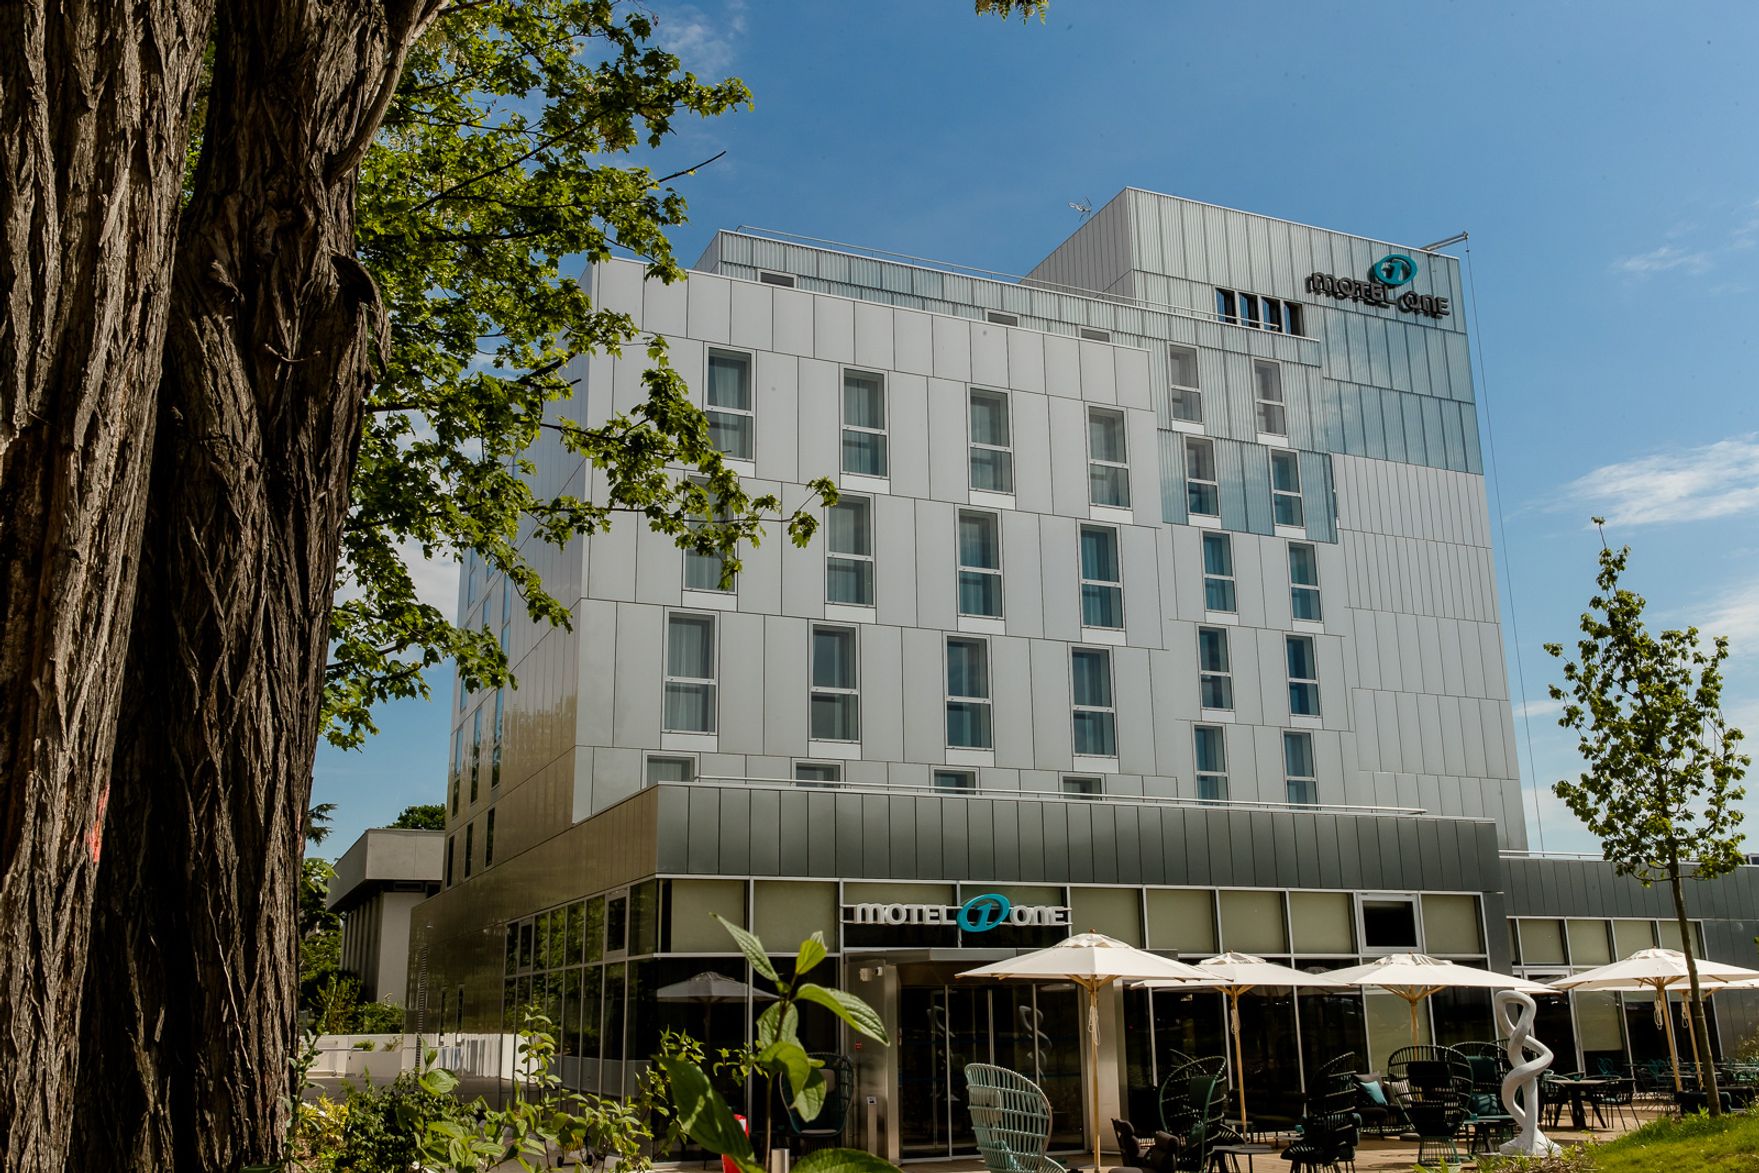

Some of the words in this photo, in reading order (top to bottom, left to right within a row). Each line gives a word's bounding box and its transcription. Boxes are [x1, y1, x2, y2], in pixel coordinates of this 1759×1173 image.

[1311, 272, 1397, 305] MOTEL
[1403, 291, 1450, 317] ONE
[856, 903, 957, 925] MOTEL
[1010, 905, 1068, 926] ONE
